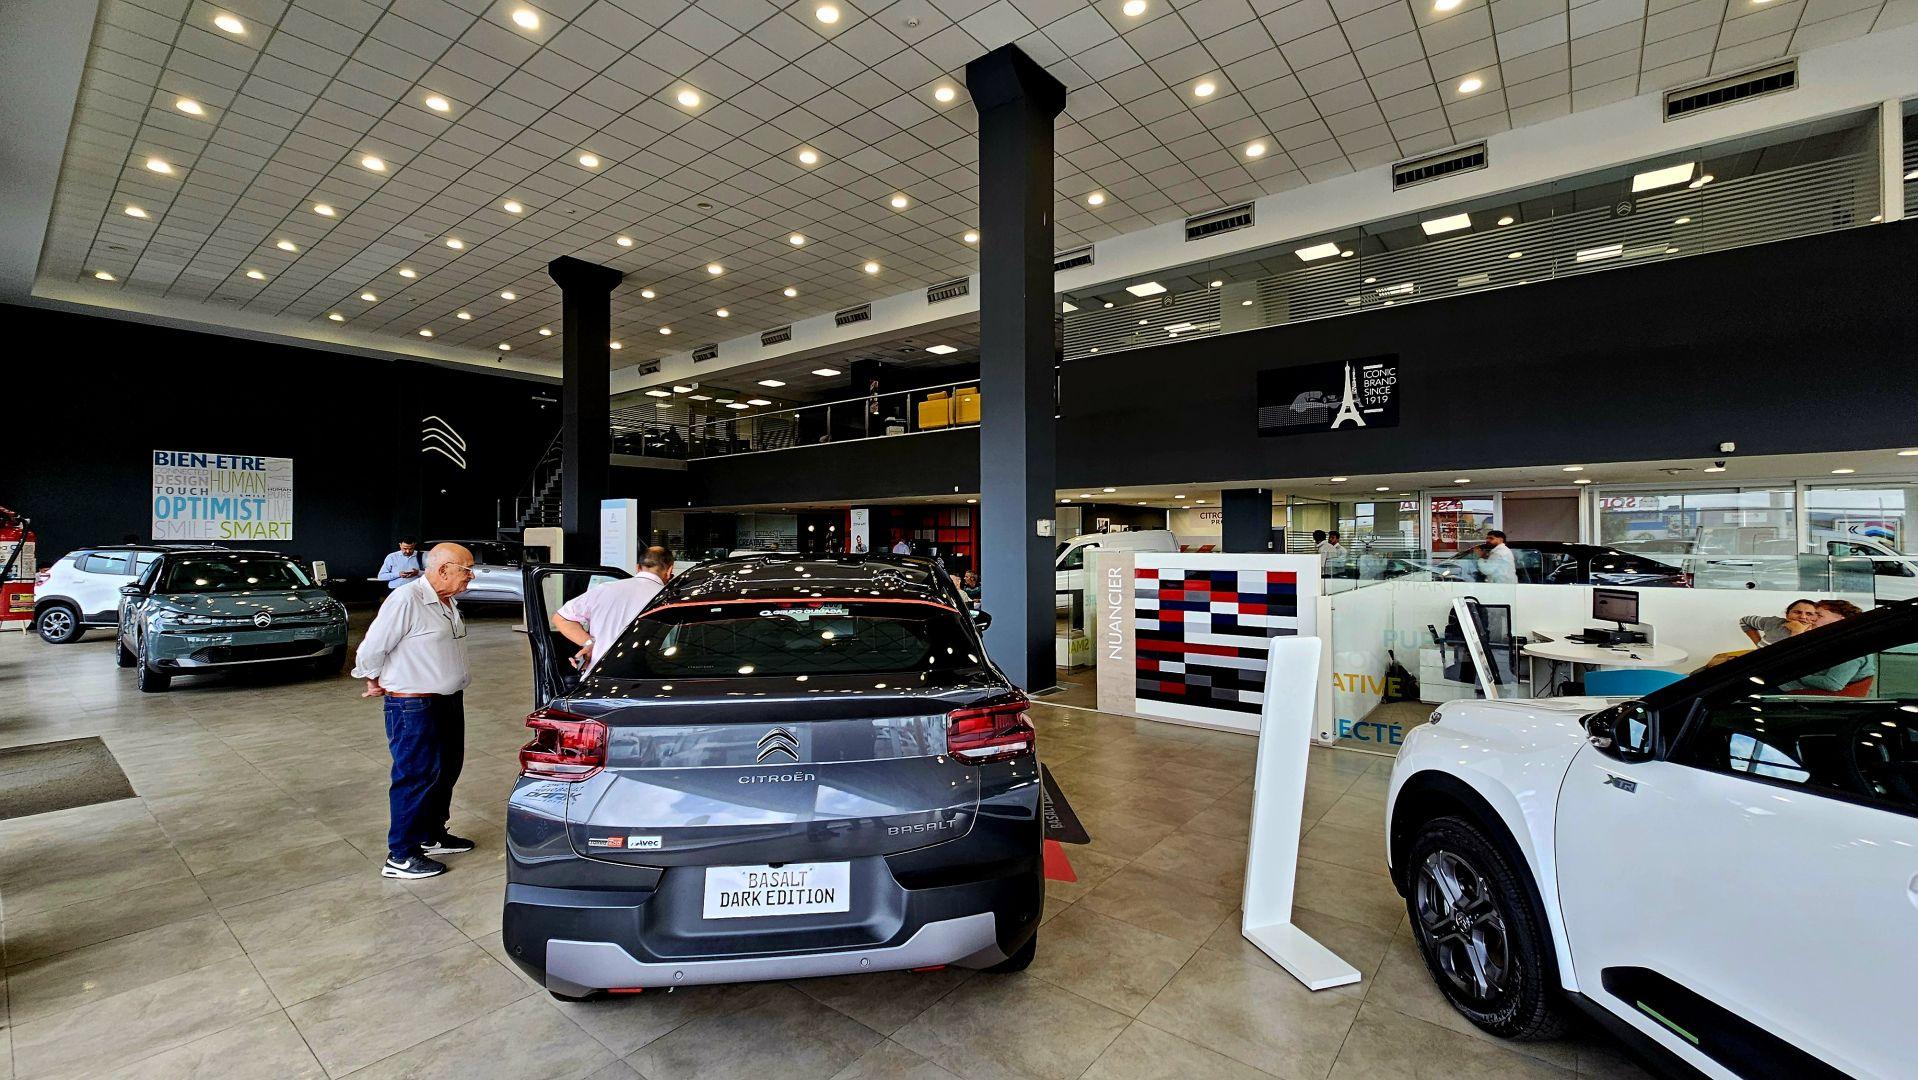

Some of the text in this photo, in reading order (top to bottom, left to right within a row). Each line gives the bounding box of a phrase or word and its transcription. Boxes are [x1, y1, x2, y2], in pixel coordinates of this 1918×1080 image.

[1364, 368, 1396, 378] ICONIC
[1364, 376, 1396, 387] BRAND
[1364, 386, 1391, 396] SINCE
[1365, 395, 1388, 404] 1919
[154, 451, 266, 471] BIEN-ETRE
[154, 475, 209, 486] DESIGN
[210, 470, 266, 493] HUMAN
[155, 486, 208, 496] TOUCH
[154, 495, 267, 521] OPTIMIST
[154, 520, 216, 539] SMILE
[220, 521, 292, 539] SMART
[1108, 567, 1122, 660] NUANCIER
[1338, 718, 1403, 746] ECTÉ
[738, 771, 816, 784] CITROËN
[887, 818, 957, 836] BASALT
[749, 871, 808, 889] BASALT
[720, 888, 835, 908] DARK EDITION
